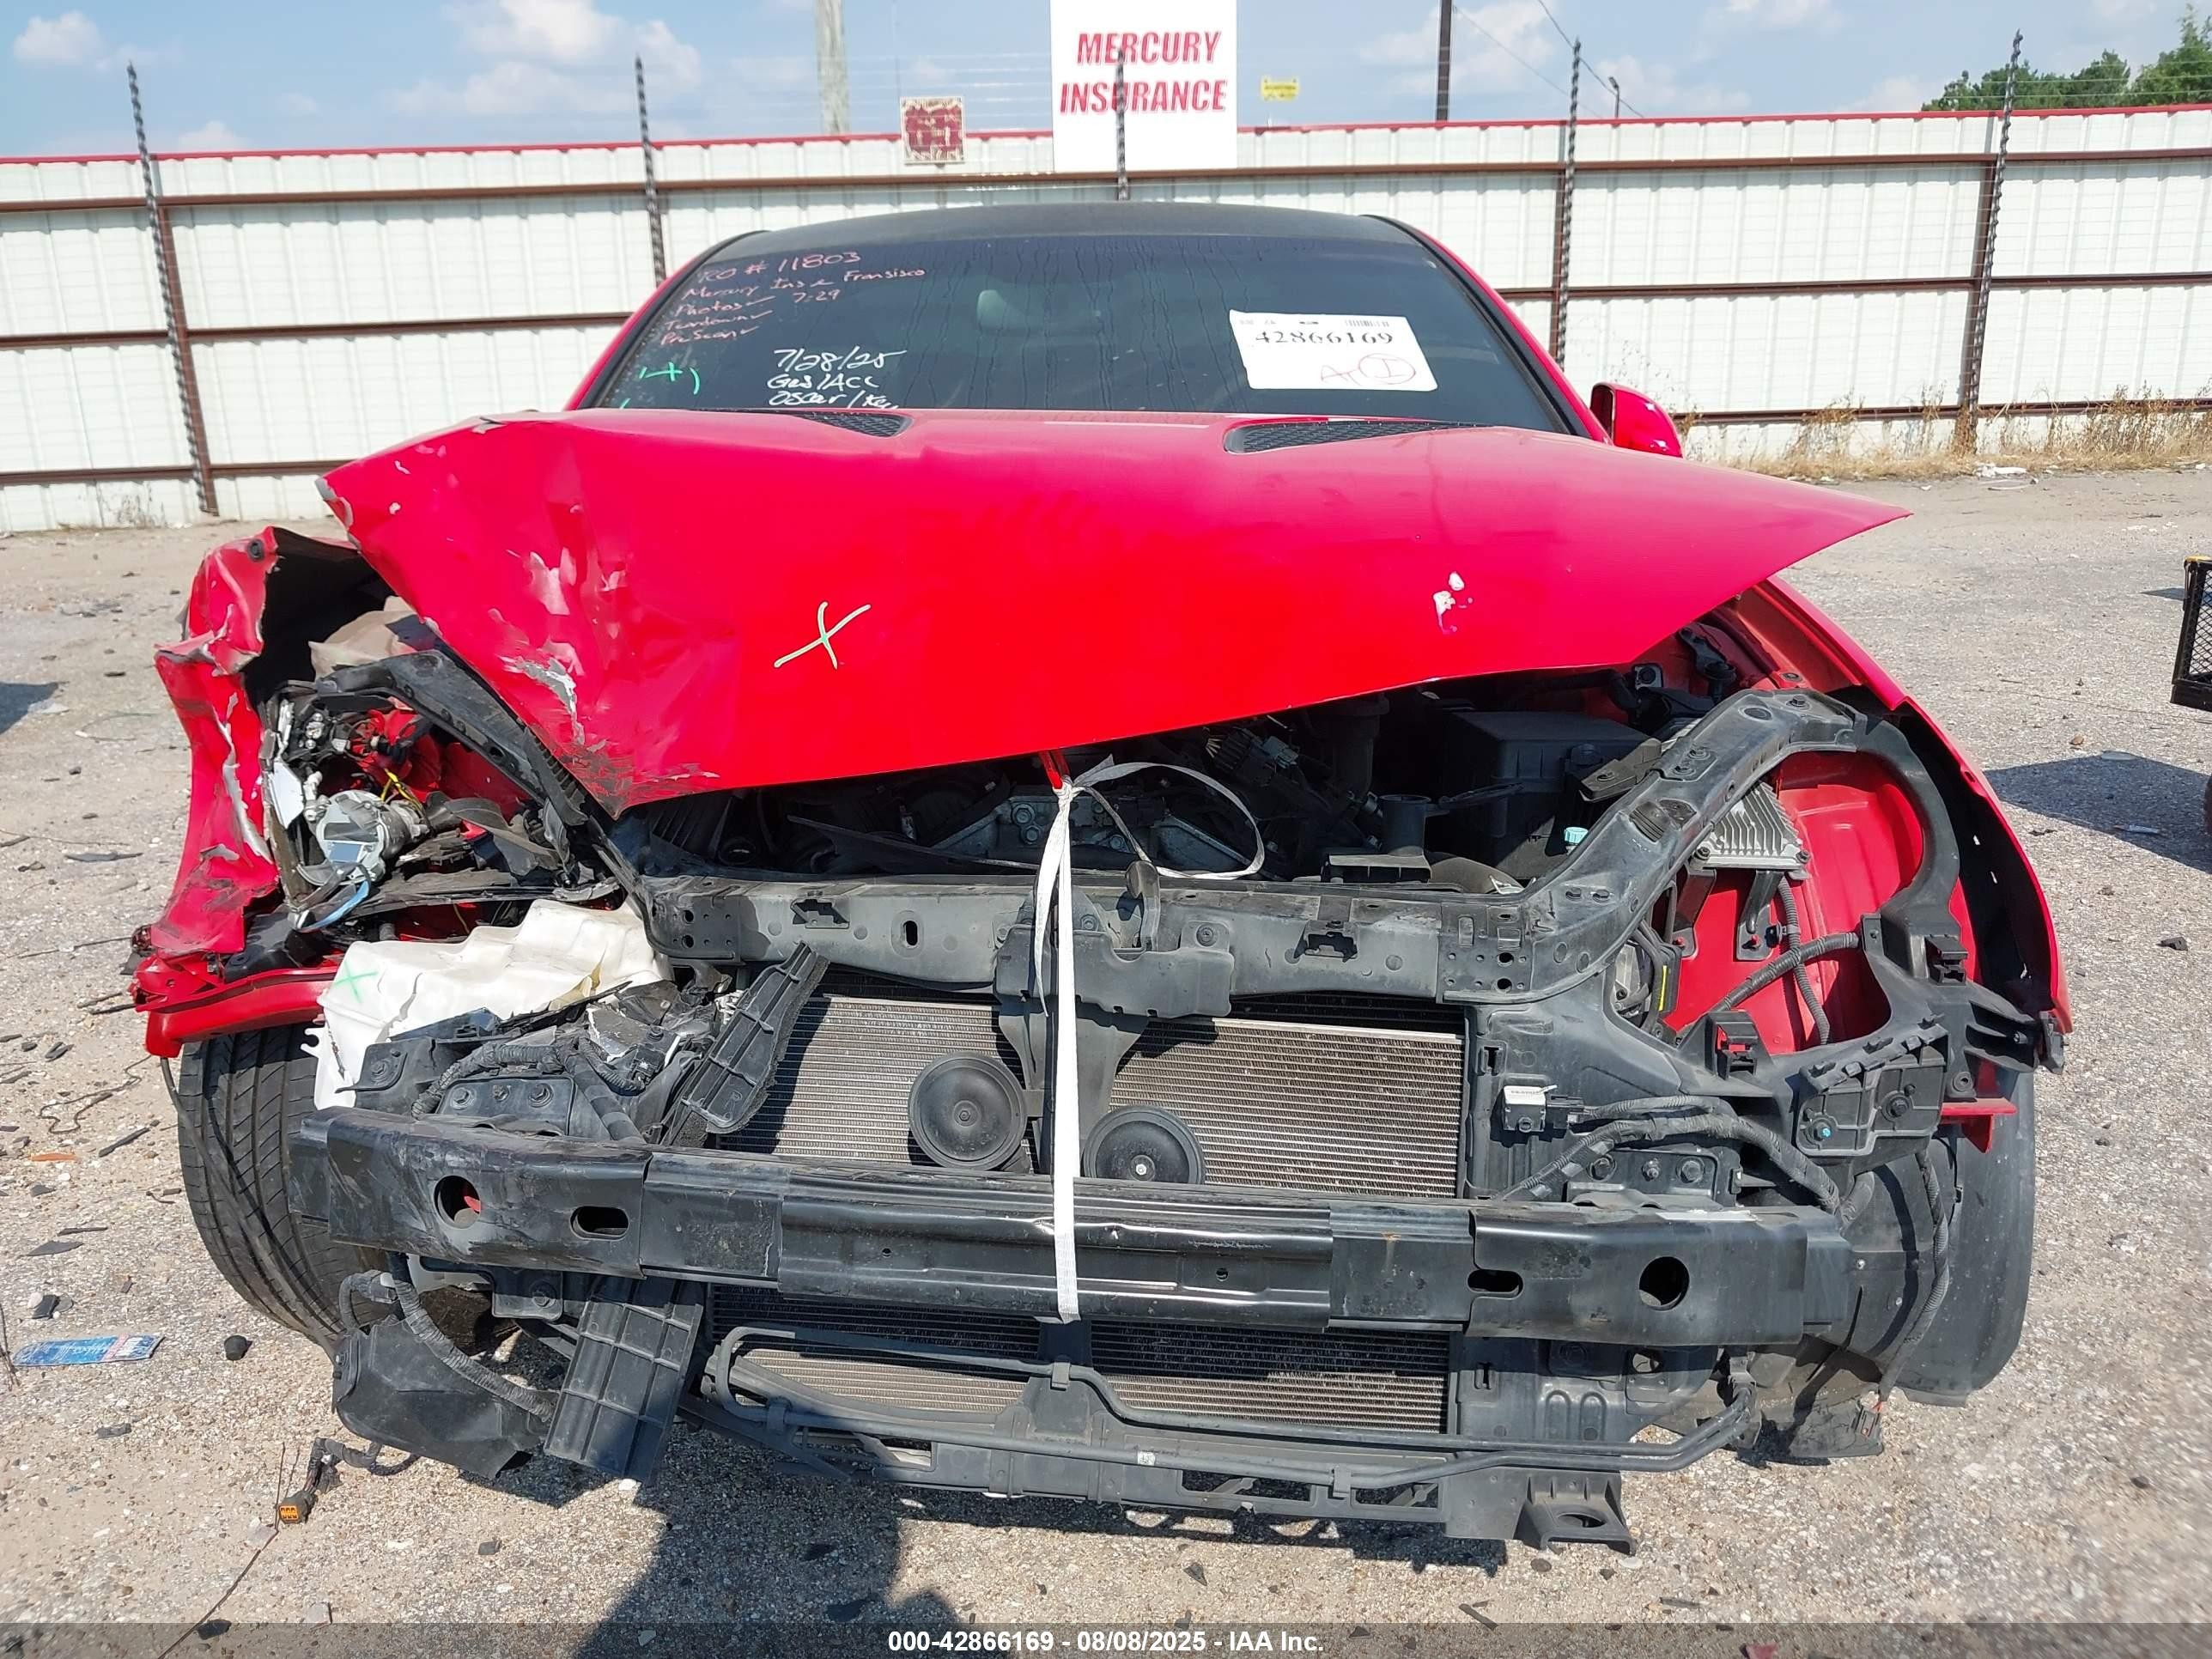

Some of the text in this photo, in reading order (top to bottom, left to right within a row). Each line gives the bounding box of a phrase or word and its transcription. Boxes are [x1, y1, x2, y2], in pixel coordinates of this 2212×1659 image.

[1077, 31, 1222, 65] MERCURY
[1060, 79, 1229, 114] INSURANCE
[744, 260, 770, 275] #
[778, 251, 861, 272] 11803
[681, 285, 759, 301] Mercury
[1255, 331, 1394, 344] 42866169
[774, 345, 908, 372] 7/28/25
